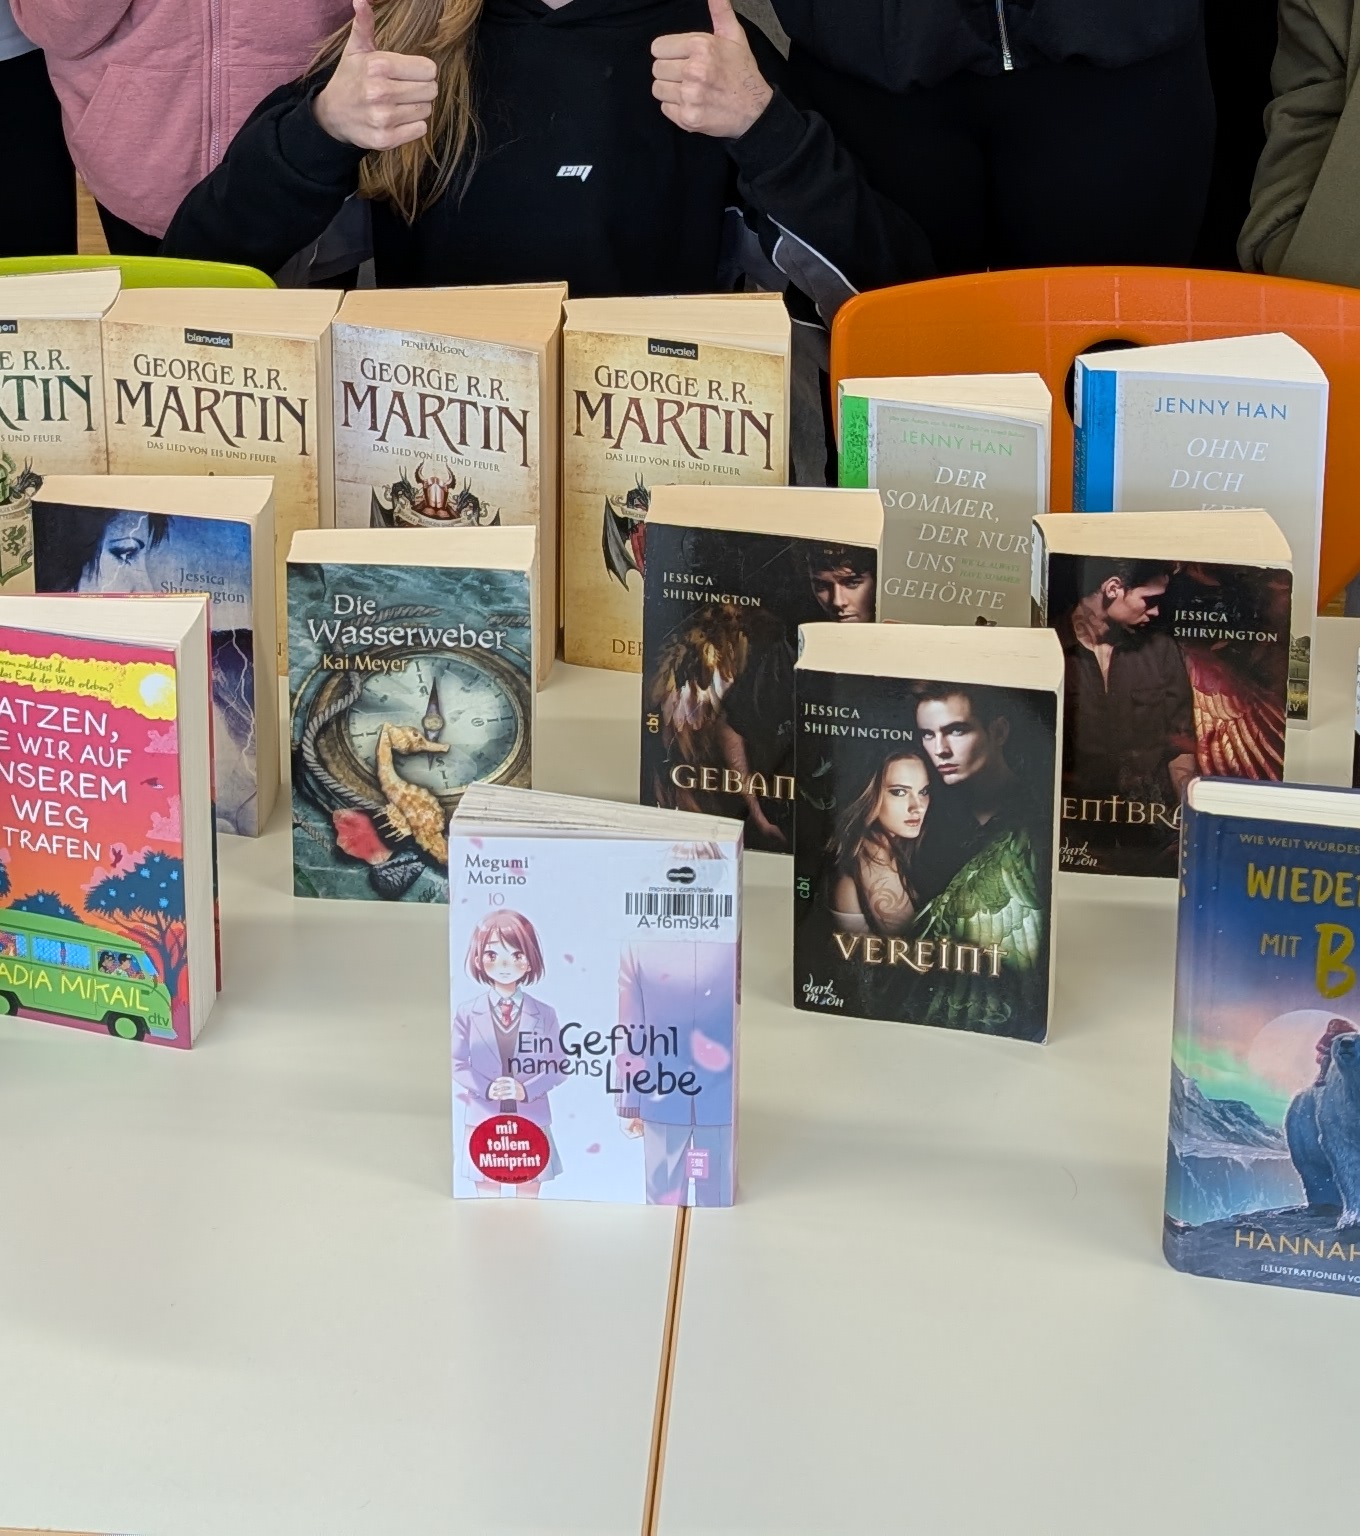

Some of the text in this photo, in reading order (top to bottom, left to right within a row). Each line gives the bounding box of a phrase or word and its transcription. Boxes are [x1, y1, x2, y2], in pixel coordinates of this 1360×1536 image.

[22, 348, 70, 371] R.R.
[650, 343, 696, 358] blanvalet
[594, 365, 753, 405] GEORGE R.R.
[1155, 396, 1288, 421] JENNY HAN
[572, 390, 774, 470] MARTIN
[1187, 437, 1268, 463] OHNE
[605, 452, 740, 476] DAS LIED VON EIS UND FEUER
[935, 466, 987, 490] DER
[1170, 470, 1244, 493] DICH
[884, 489, 1000, 524] SOMMER,
[918, 523, 1030, 555] DER NUR
[906, 550, 956, 575] UNS
[335, 594, 376, 616] Die
[884, 576, 1006, 611] GEHÖRTE
[308, 618, 507, 650] Wasserweber
[55, 661, 66, 673] du
[323, 653, 409, 673] Kai Meyer
[16, 670, 36, 682] Ende
[39, 673, 52, 684] der
[56, 675, 75, 687] Welt
[78, 680, 113, 693] erleben?
[804, 703, 860, 719] JESSICA
[646, 713, 660, 734] cbt
[804, 722, 913, 742] SHIRVINGTON
[18, 732, 73, 762] WIR
[79, 745, 131, 770] AUF
[10, 795, 89, 833] WEG
[3, 825, 101, 862] TRAFEN
[1240, 834, 1264, 845] WIE
[1268, 836, 1300, 849] WEIT
[465, 854, 528, 871] Megumi
[467, 871, 527, 886] Morino
[637, 915, 720, 931] A-f6m9k4
[833, 933, 1008, 978] VEREINT
[1260, 932, 1302, 957] MIT
[61, 975, 150, 1012] MIKAIL
[148, 1011, 169, 1027] dtv
[518, 1021, 679, 1058] Ein Gefühl
[507, 1056, 603, 1077] namens
[605, 1059, 702, 1096] Liebe
[496, 1120, 518, 1135] mit
[487, 1136, 530, 1151] tollem
[479, 1153, 541, 1171] Miniprint
[1260, 1264, 1345, 1282] ILLUSTRATIONEN
